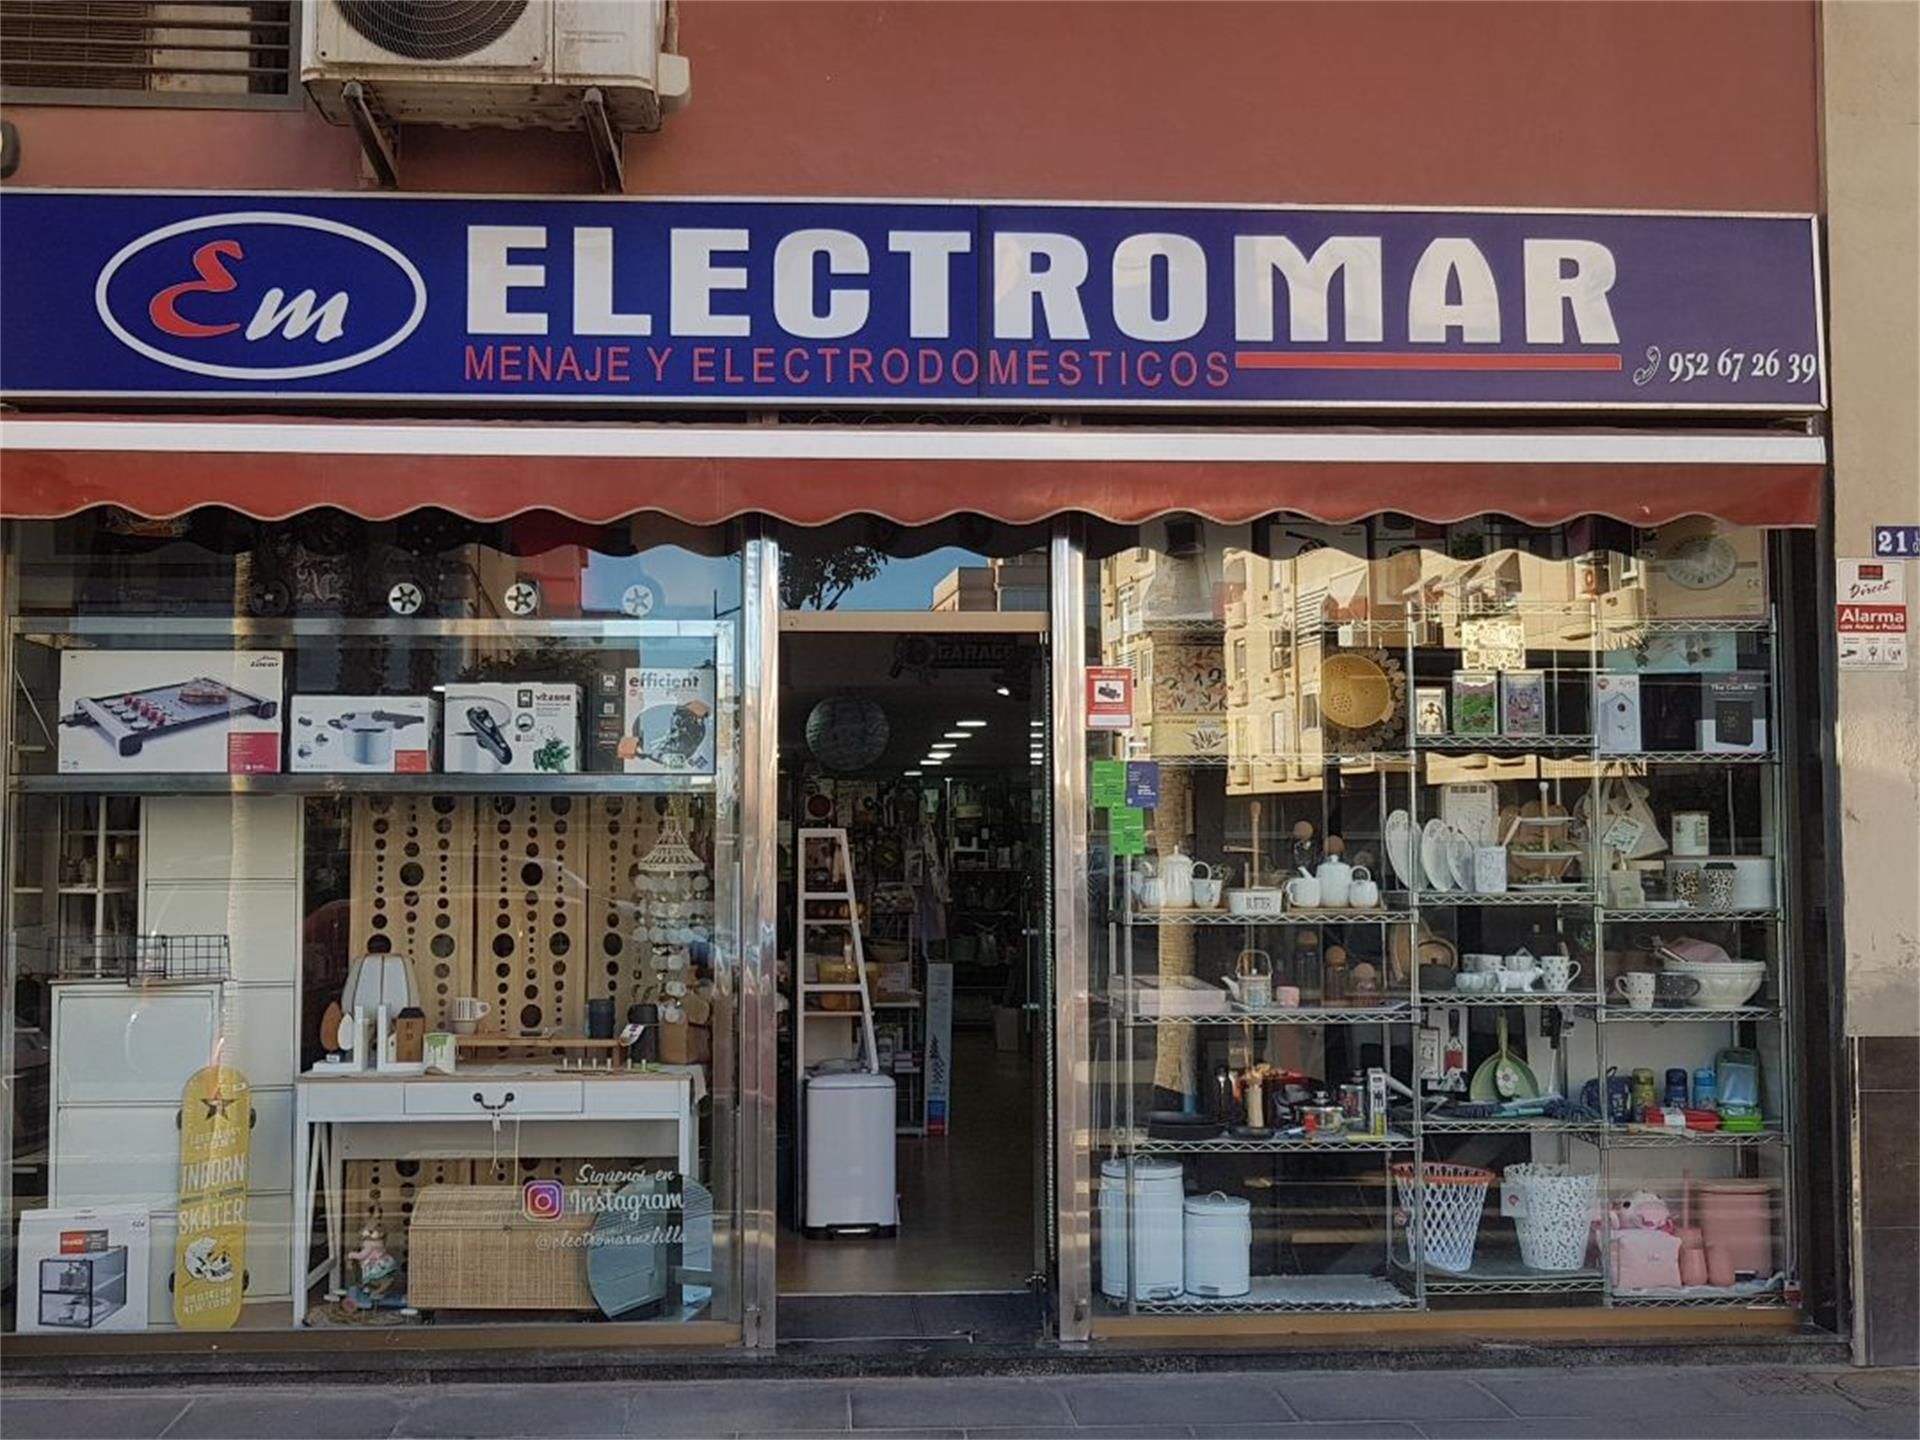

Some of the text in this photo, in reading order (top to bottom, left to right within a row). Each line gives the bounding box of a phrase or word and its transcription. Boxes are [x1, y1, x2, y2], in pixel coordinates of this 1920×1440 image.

[466, 224, 1622, 345] ELECTROMAR
[463, 345, 1230, 388] MENAJE Y ELECTRODOMESTICOS
[1668, 347, 1817, 384] 952 67 26 39
[1878, 530, 1908, 553] 21
[1840, 608, 1904, 622] Alarma
[629, 673, 699, 689] efficient
[655, 1169, 675, 1181] en
[178, 1198, 243, 1234] SKATER
[570, 1190, 684, 1220] Instagram
